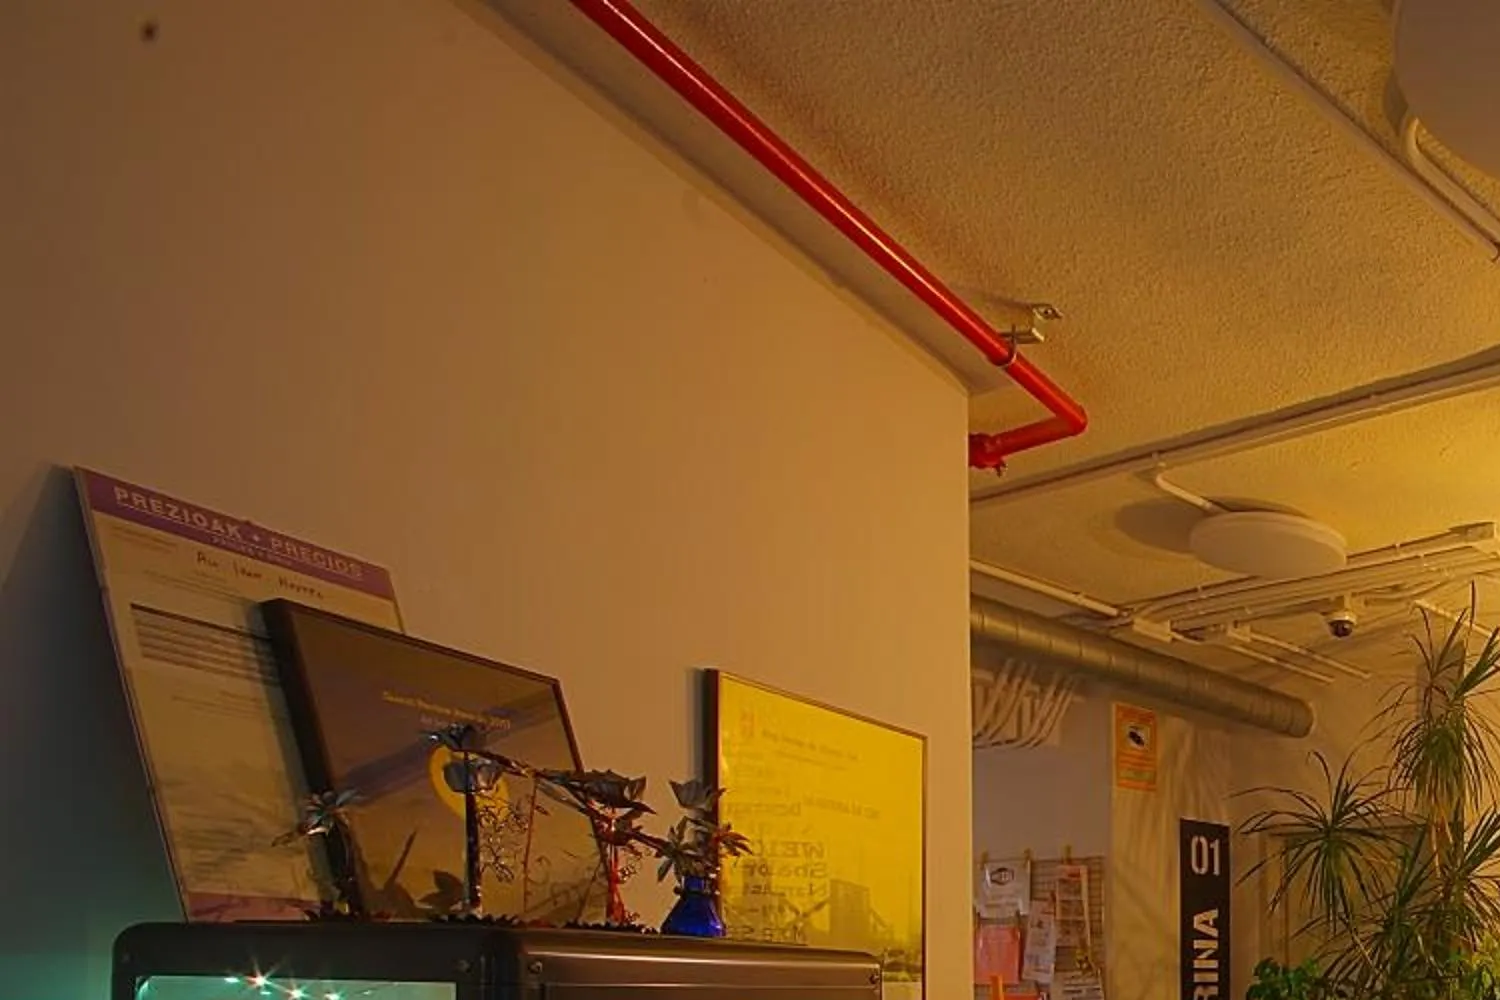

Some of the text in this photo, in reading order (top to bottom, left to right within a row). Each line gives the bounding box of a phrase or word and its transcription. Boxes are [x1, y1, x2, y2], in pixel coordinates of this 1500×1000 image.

[114, 486, 243, 541] PREZIOAK
[270, 537, 364, 579] PRECIOS
[1191, 834, 1221, 877] 01
